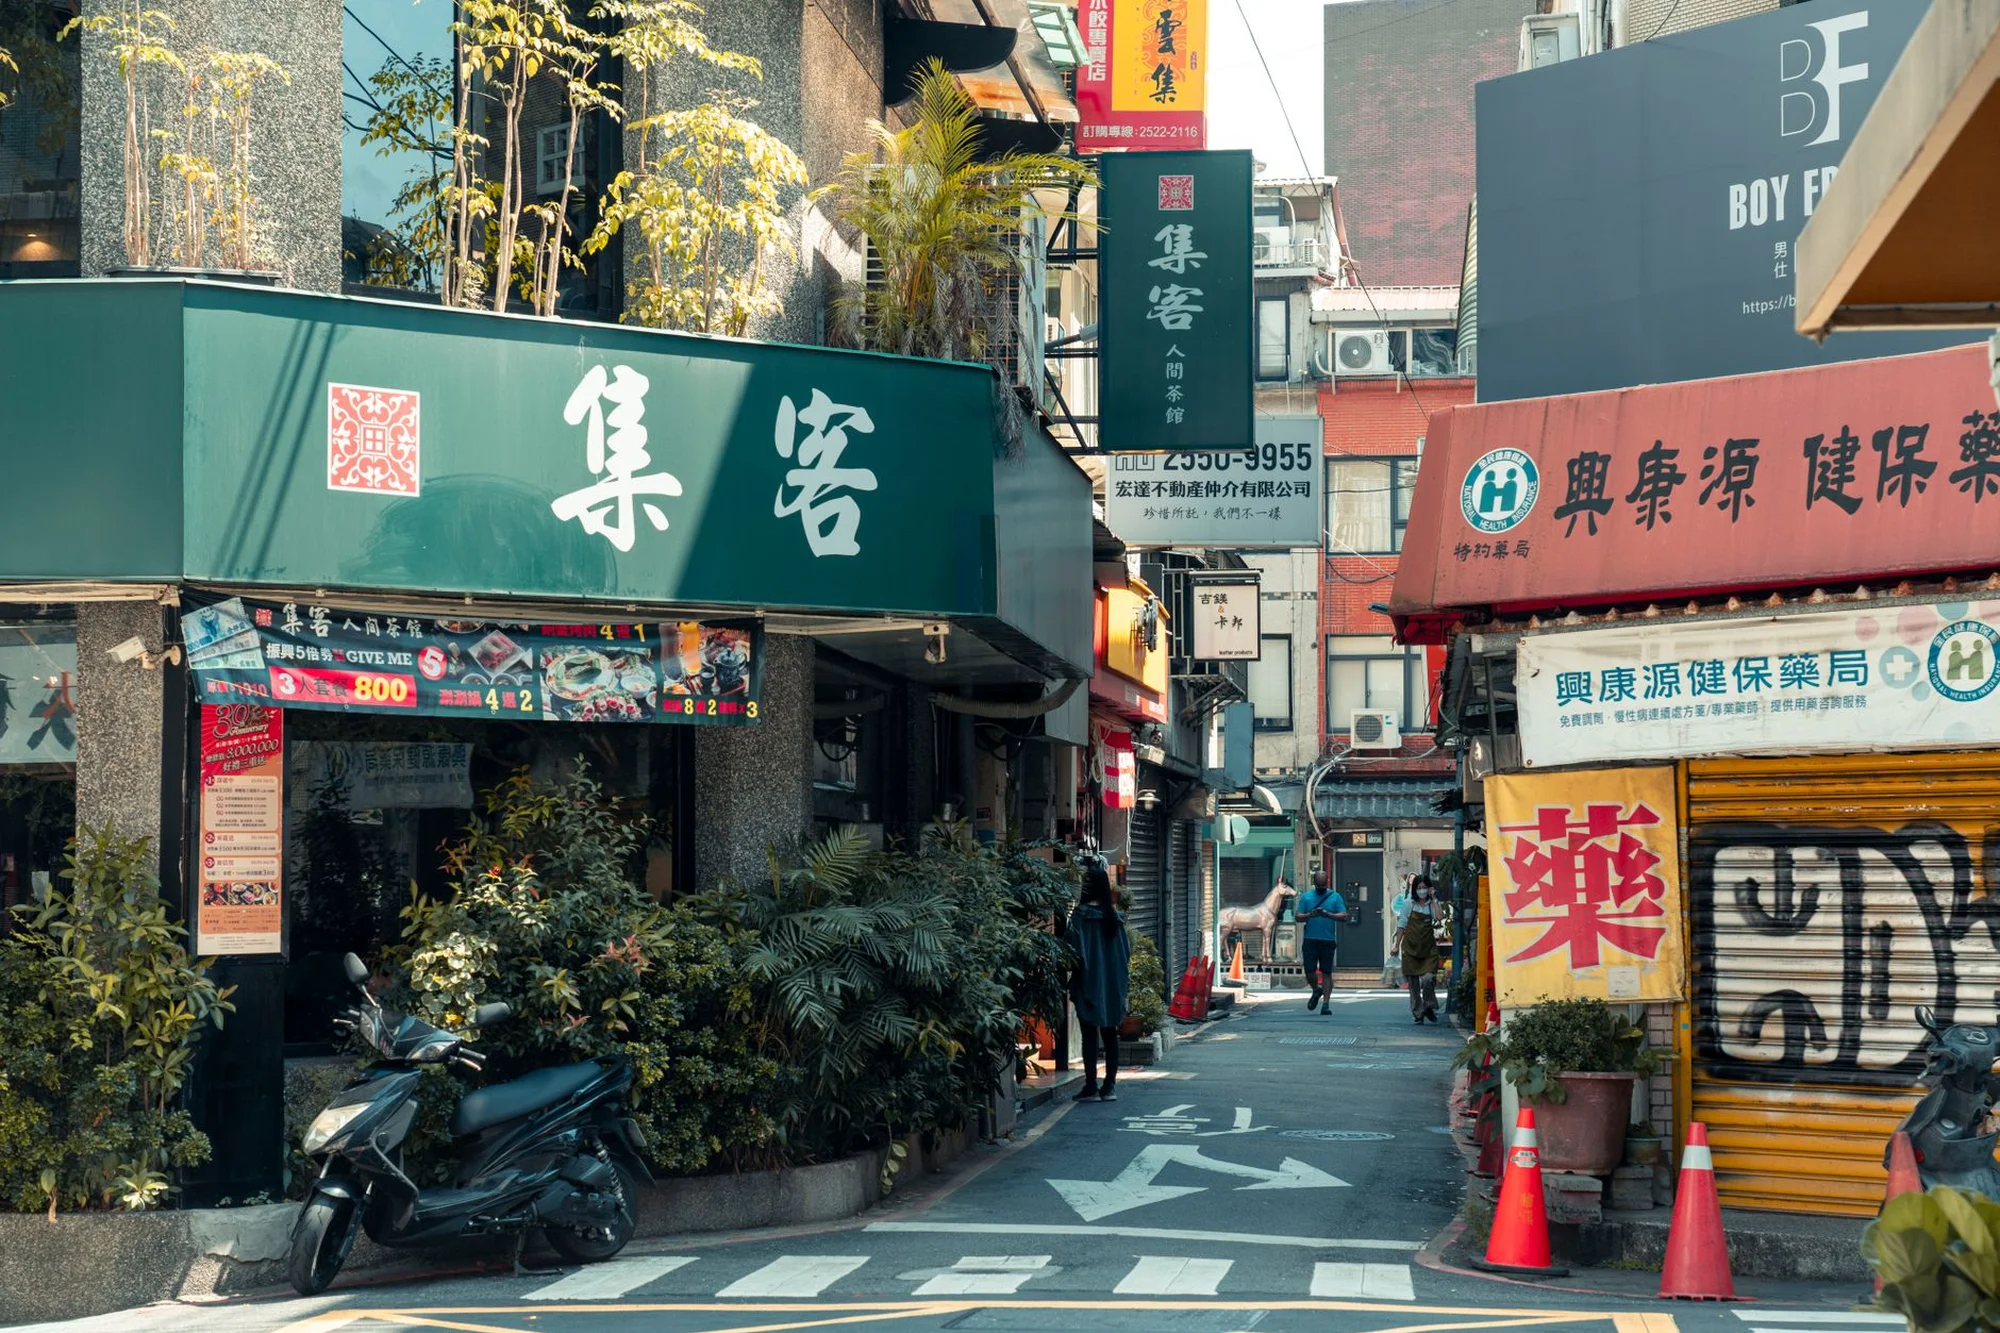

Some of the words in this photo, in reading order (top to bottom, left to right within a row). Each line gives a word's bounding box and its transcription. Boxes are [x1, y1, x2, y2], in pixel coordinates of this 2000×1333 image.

[1729, 174, 1790, 230] BOY
[1146, 223, 1208, 331] 集客
[1774, 241, 1788, 279] 男仕
[1165, 344, 1186, 425] 人間茶館
[551, 365, 879, 558] 集客
[1115, 480, 1311, 499] 宏達不動產仲介有限公司
[1554, 439, 1761, 539] 興康源
[1463, 485, 1477, 521] NATIONAL
[1479, 519, 1507, 530] HEALTH
[1512, 480, 1537, 522] INSURANCE
[281, 603, 331, 638] 集客
[346, 650, 385, 666] GIVE
[387, 652, 413, 667] ME
[420, 647, 444, 677] 5
[353, 675, 409, 702] 800
[1555, 649, 1869, 708] 興康源健保藥局
[1499, 803, 1667, 969] 藥
